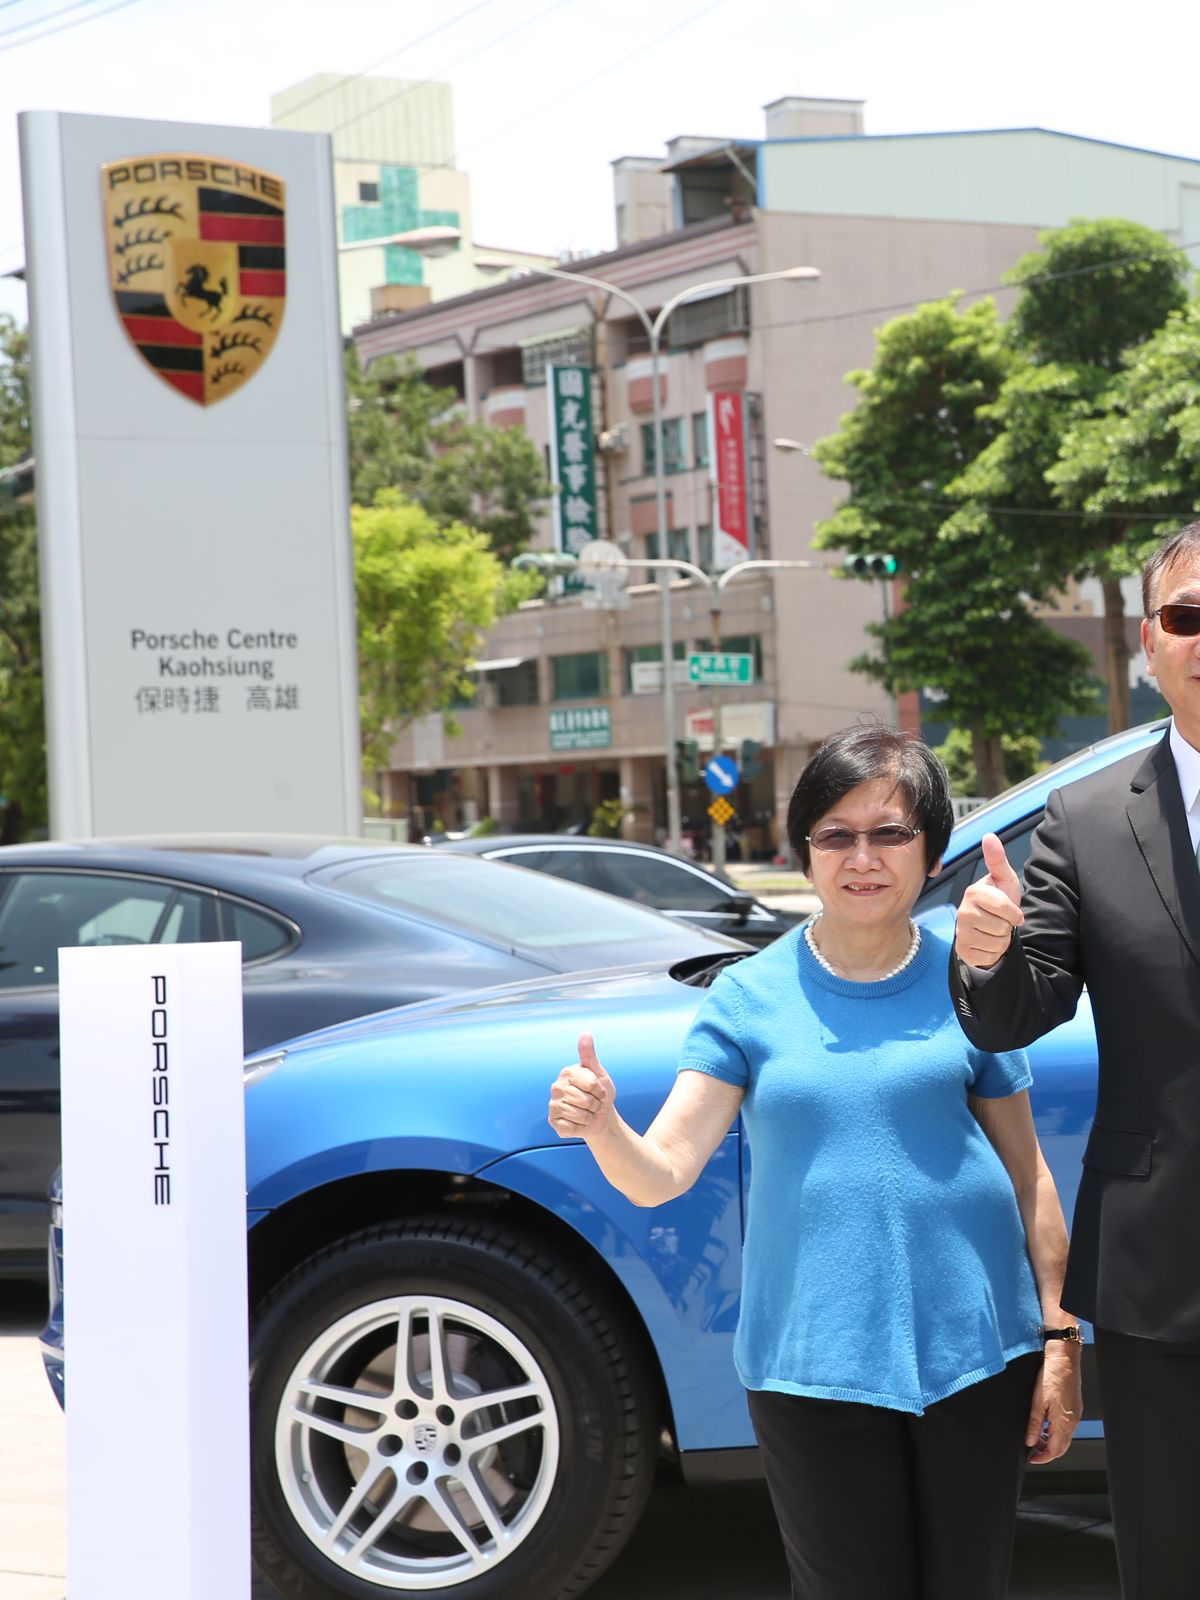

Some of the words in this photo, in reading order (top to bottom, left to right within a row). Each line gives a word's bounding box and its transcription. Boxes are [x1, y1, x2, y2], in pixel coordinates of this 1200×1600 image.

[107, 159, 283, 201] PORSCHE
[131, 629, 219, 650] Porsche
[227, 628, 298, 649] Centre
[159, 656, 275, 680] Kaohsiung
[135, 685, 220, 714] 保時捷
[246, 683, 301, 712] 高雄
[151, 975, 170, 1206] PORSCHE
